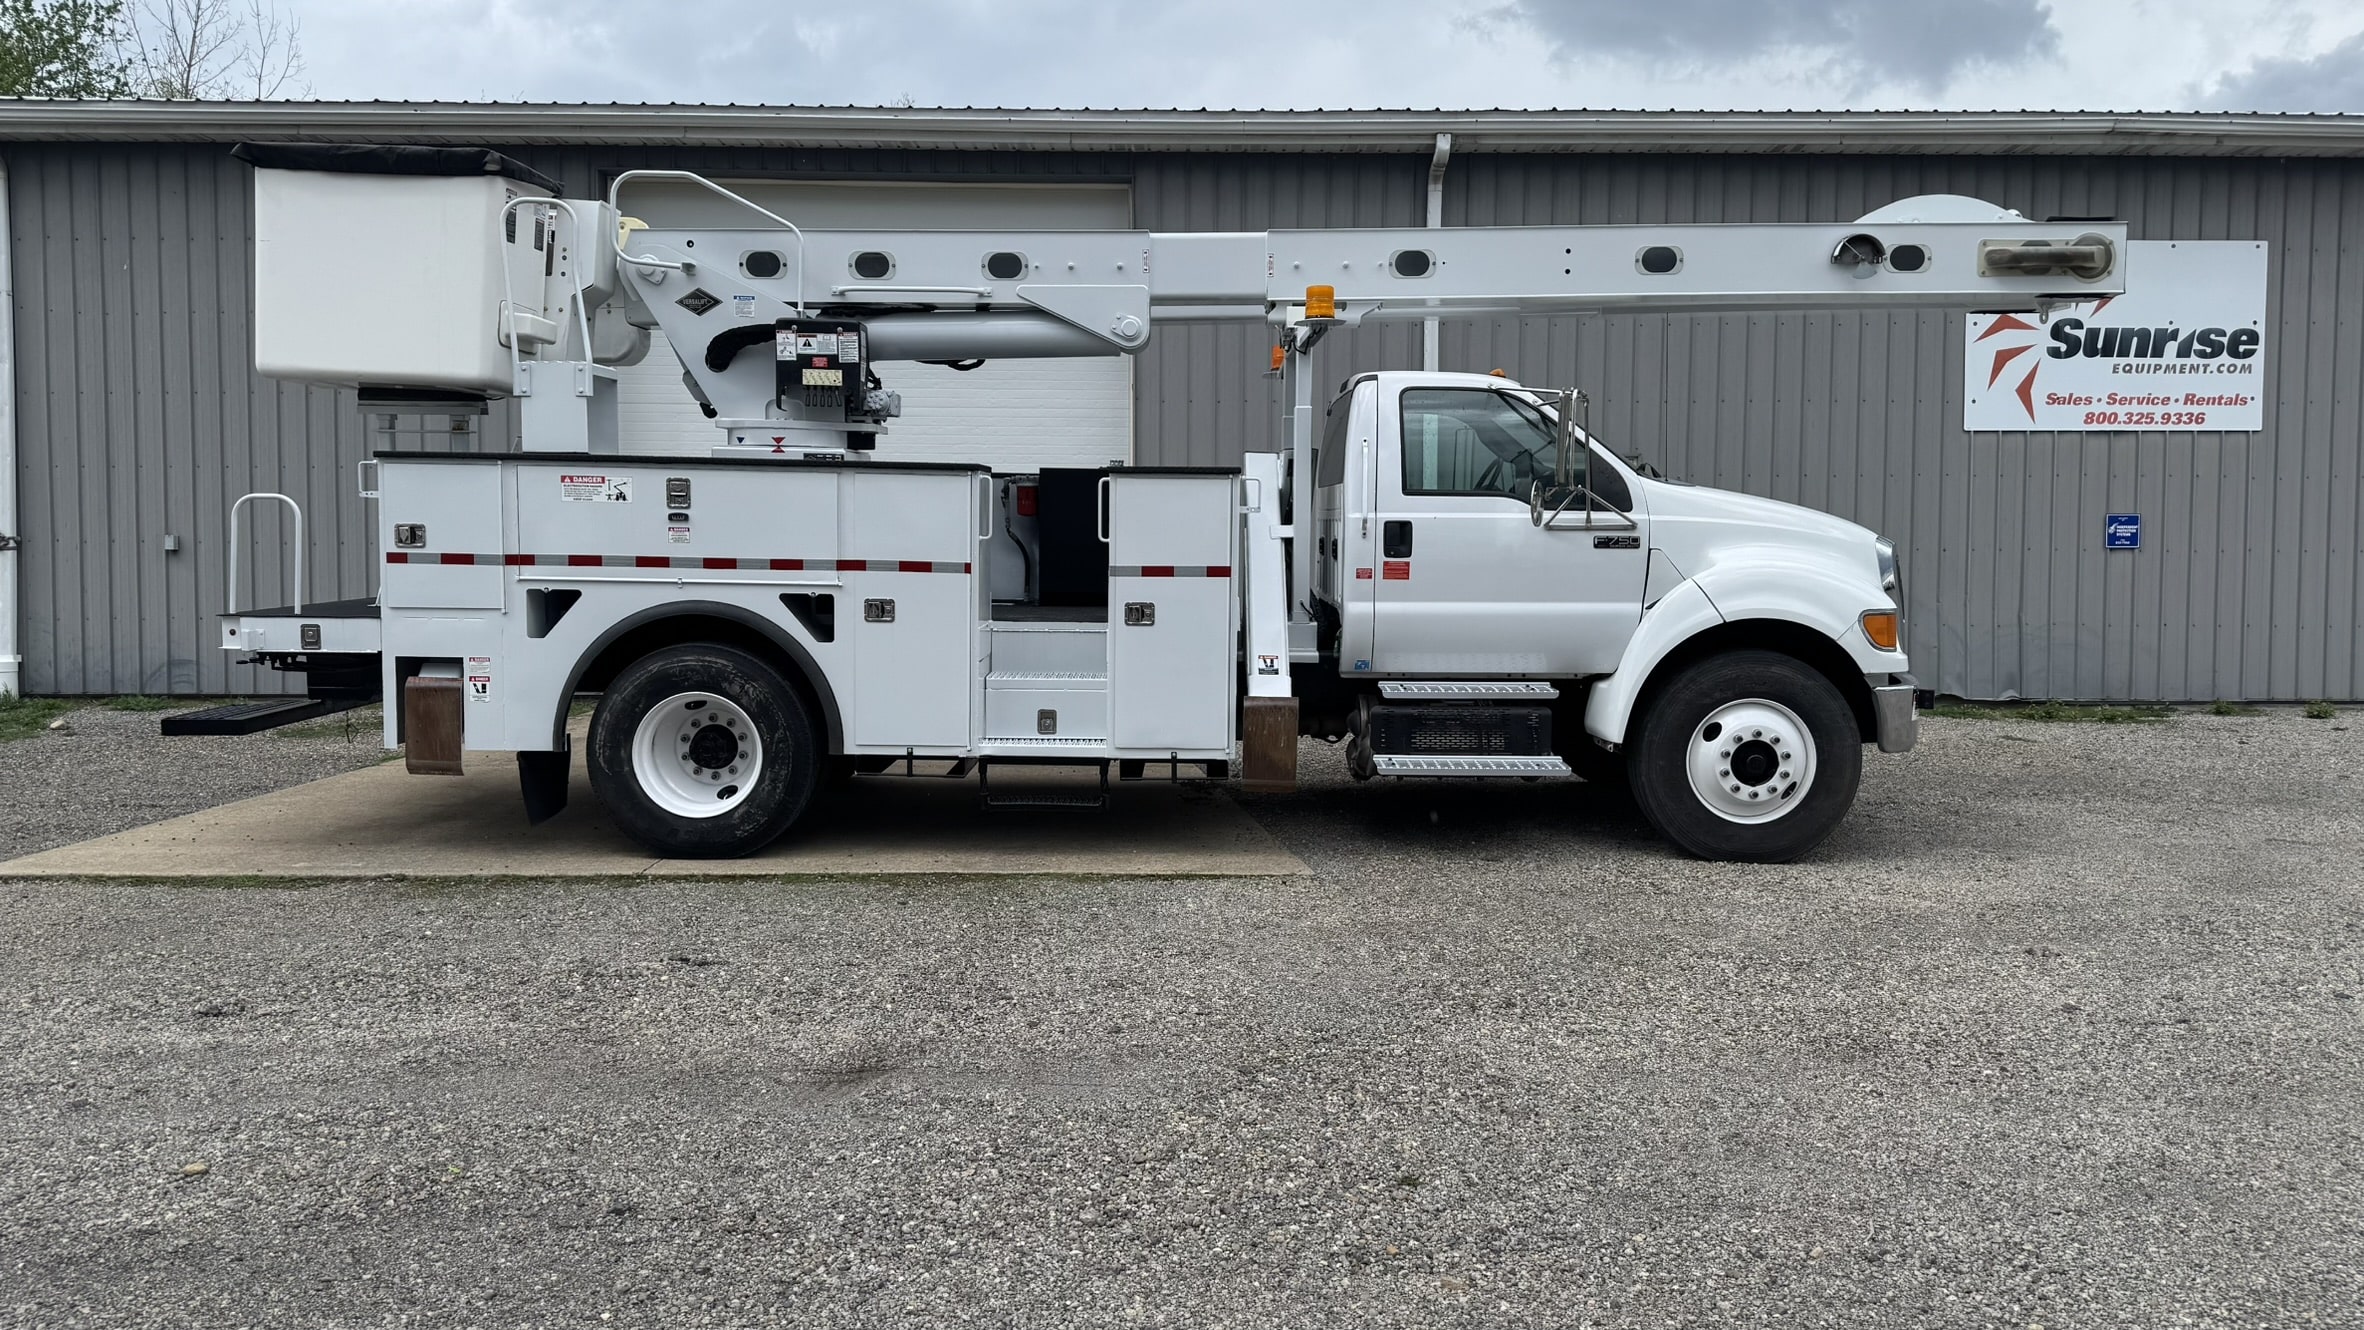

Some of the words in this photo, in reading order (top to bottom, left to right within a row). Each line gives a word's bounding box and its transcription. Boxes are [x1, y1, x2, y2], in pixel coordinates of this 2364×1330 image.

[2046, 317, 2260, 360] Sunrise
[2111, 362, 2253, 375] EQUIPMENT.COM
[2045, 392, 2093, 406] Sales
[2105, 392, 2171, 406] Service
[2182, 392, 2249, 407] Rentals
[2083, 411, 2207, 426] 800.325.9336
[572, 476, 603, 484] DANGER
